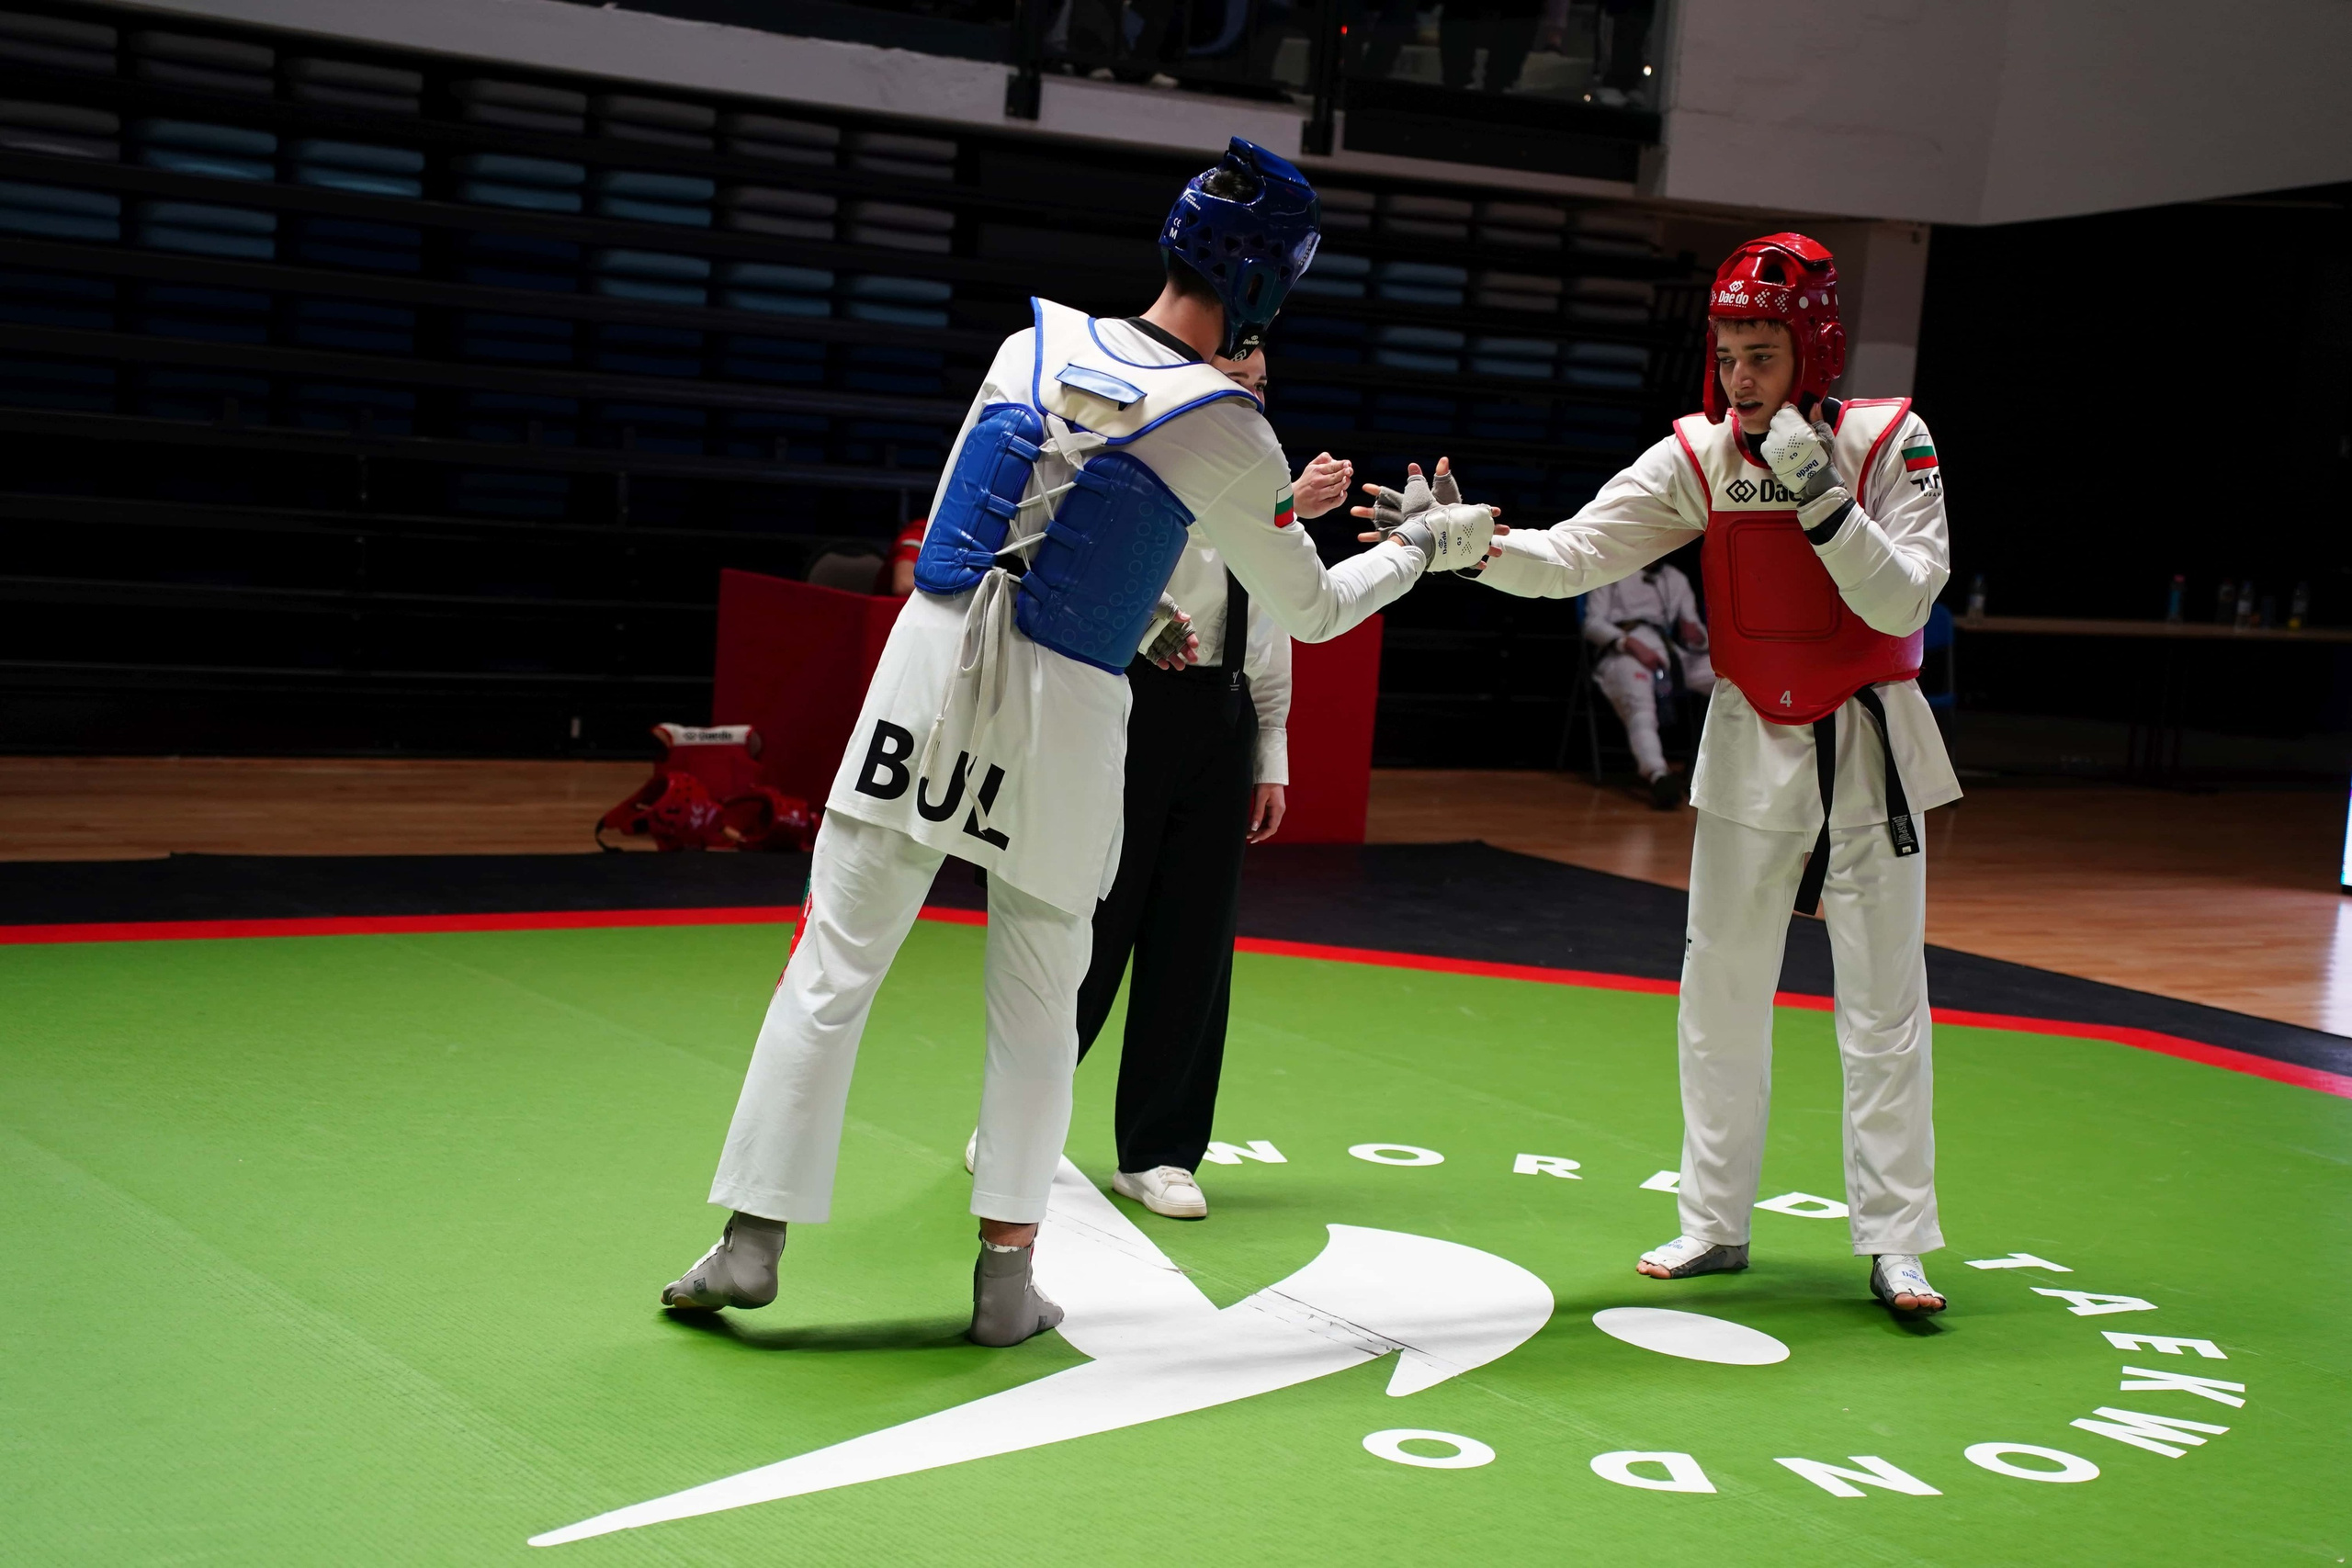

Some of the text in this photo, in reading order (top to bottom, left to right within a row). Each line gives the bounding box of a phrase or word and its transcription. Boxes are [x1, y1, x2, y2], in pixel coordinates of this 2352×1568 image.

[1795, 458, 1820, 479] Daedo
[1760, 479, 1803, 502] Dae
[1780, 690, 1792, 707] 4
[855, 719, 1010, 852] BUL
[1202, 1141, 2245, 1497] WORLD TAEKWONDO
